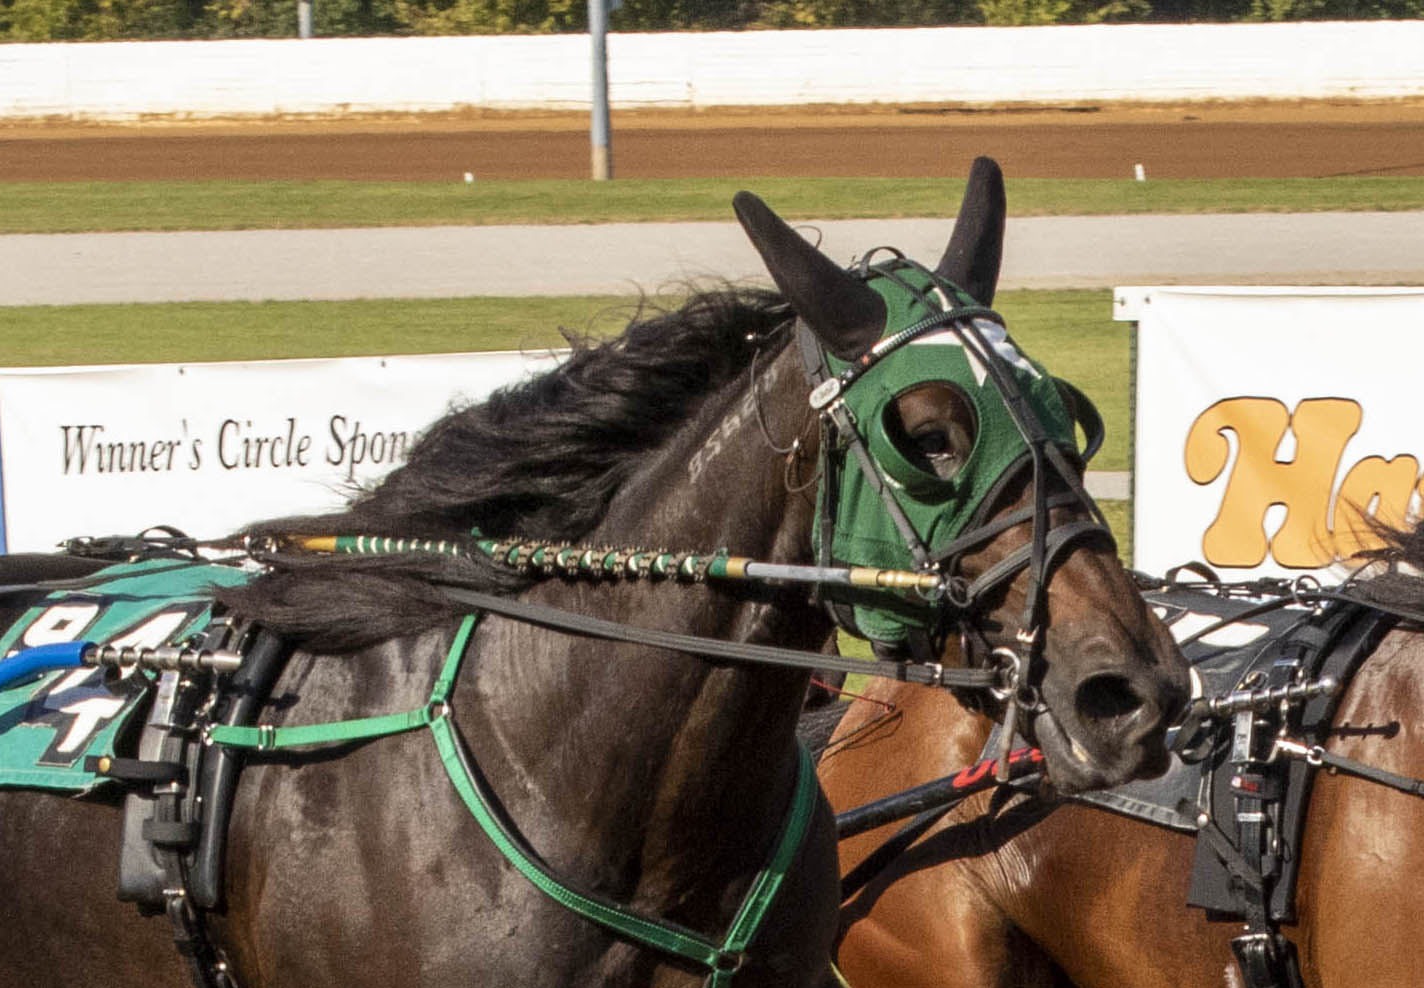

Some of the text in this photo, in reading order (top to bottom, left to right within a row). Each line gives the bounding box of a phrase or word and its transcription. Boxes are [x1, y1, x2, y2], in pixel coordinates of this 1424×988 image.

[60, 414, 422, 483] Winner's Circle Spon
